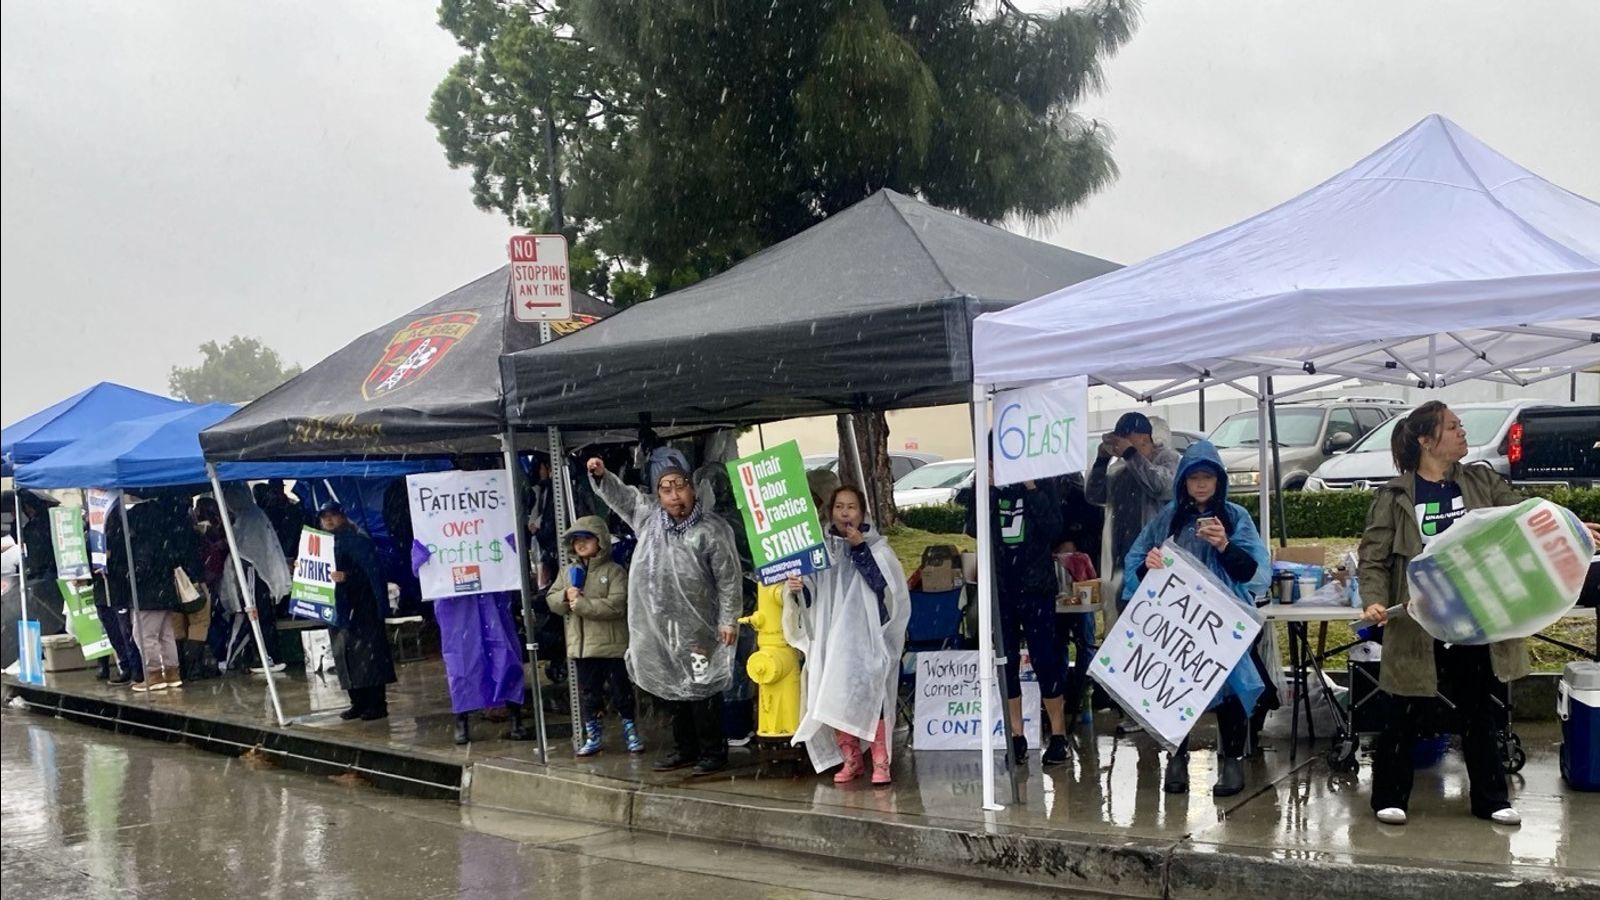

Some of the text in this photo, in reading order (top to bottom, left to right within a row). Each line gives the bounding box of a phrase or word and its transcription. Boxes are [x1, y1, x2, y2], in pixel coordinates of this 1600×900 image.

[513, 240, 533, 258] NO
[515, 265, 566, 280] STOPPING
[520, 284, 565, 296] ANY TIME
[742, 456, 782, 487] Unfair
[419, 487, 499, 511] PATIENTS
[749, 479, 788, 509] Labor
[755, 497, 808, 531] Practice
[1527, 508, 1560, 539] ON
[442, 519, 484, 537] over
[308, 533, 321, 557] ON
[761, 521, 815, 562] STRIKE
[298, 558, 332, 583] STRIKE
[1158, 573, 1224, 645] FAIR
[1130, 600, 1228, 691] CONTRACT
[923, 658, 977, 684] Working
[1123, 643, 1194, 709] NOW
[923, 683, 969, 698] corner
